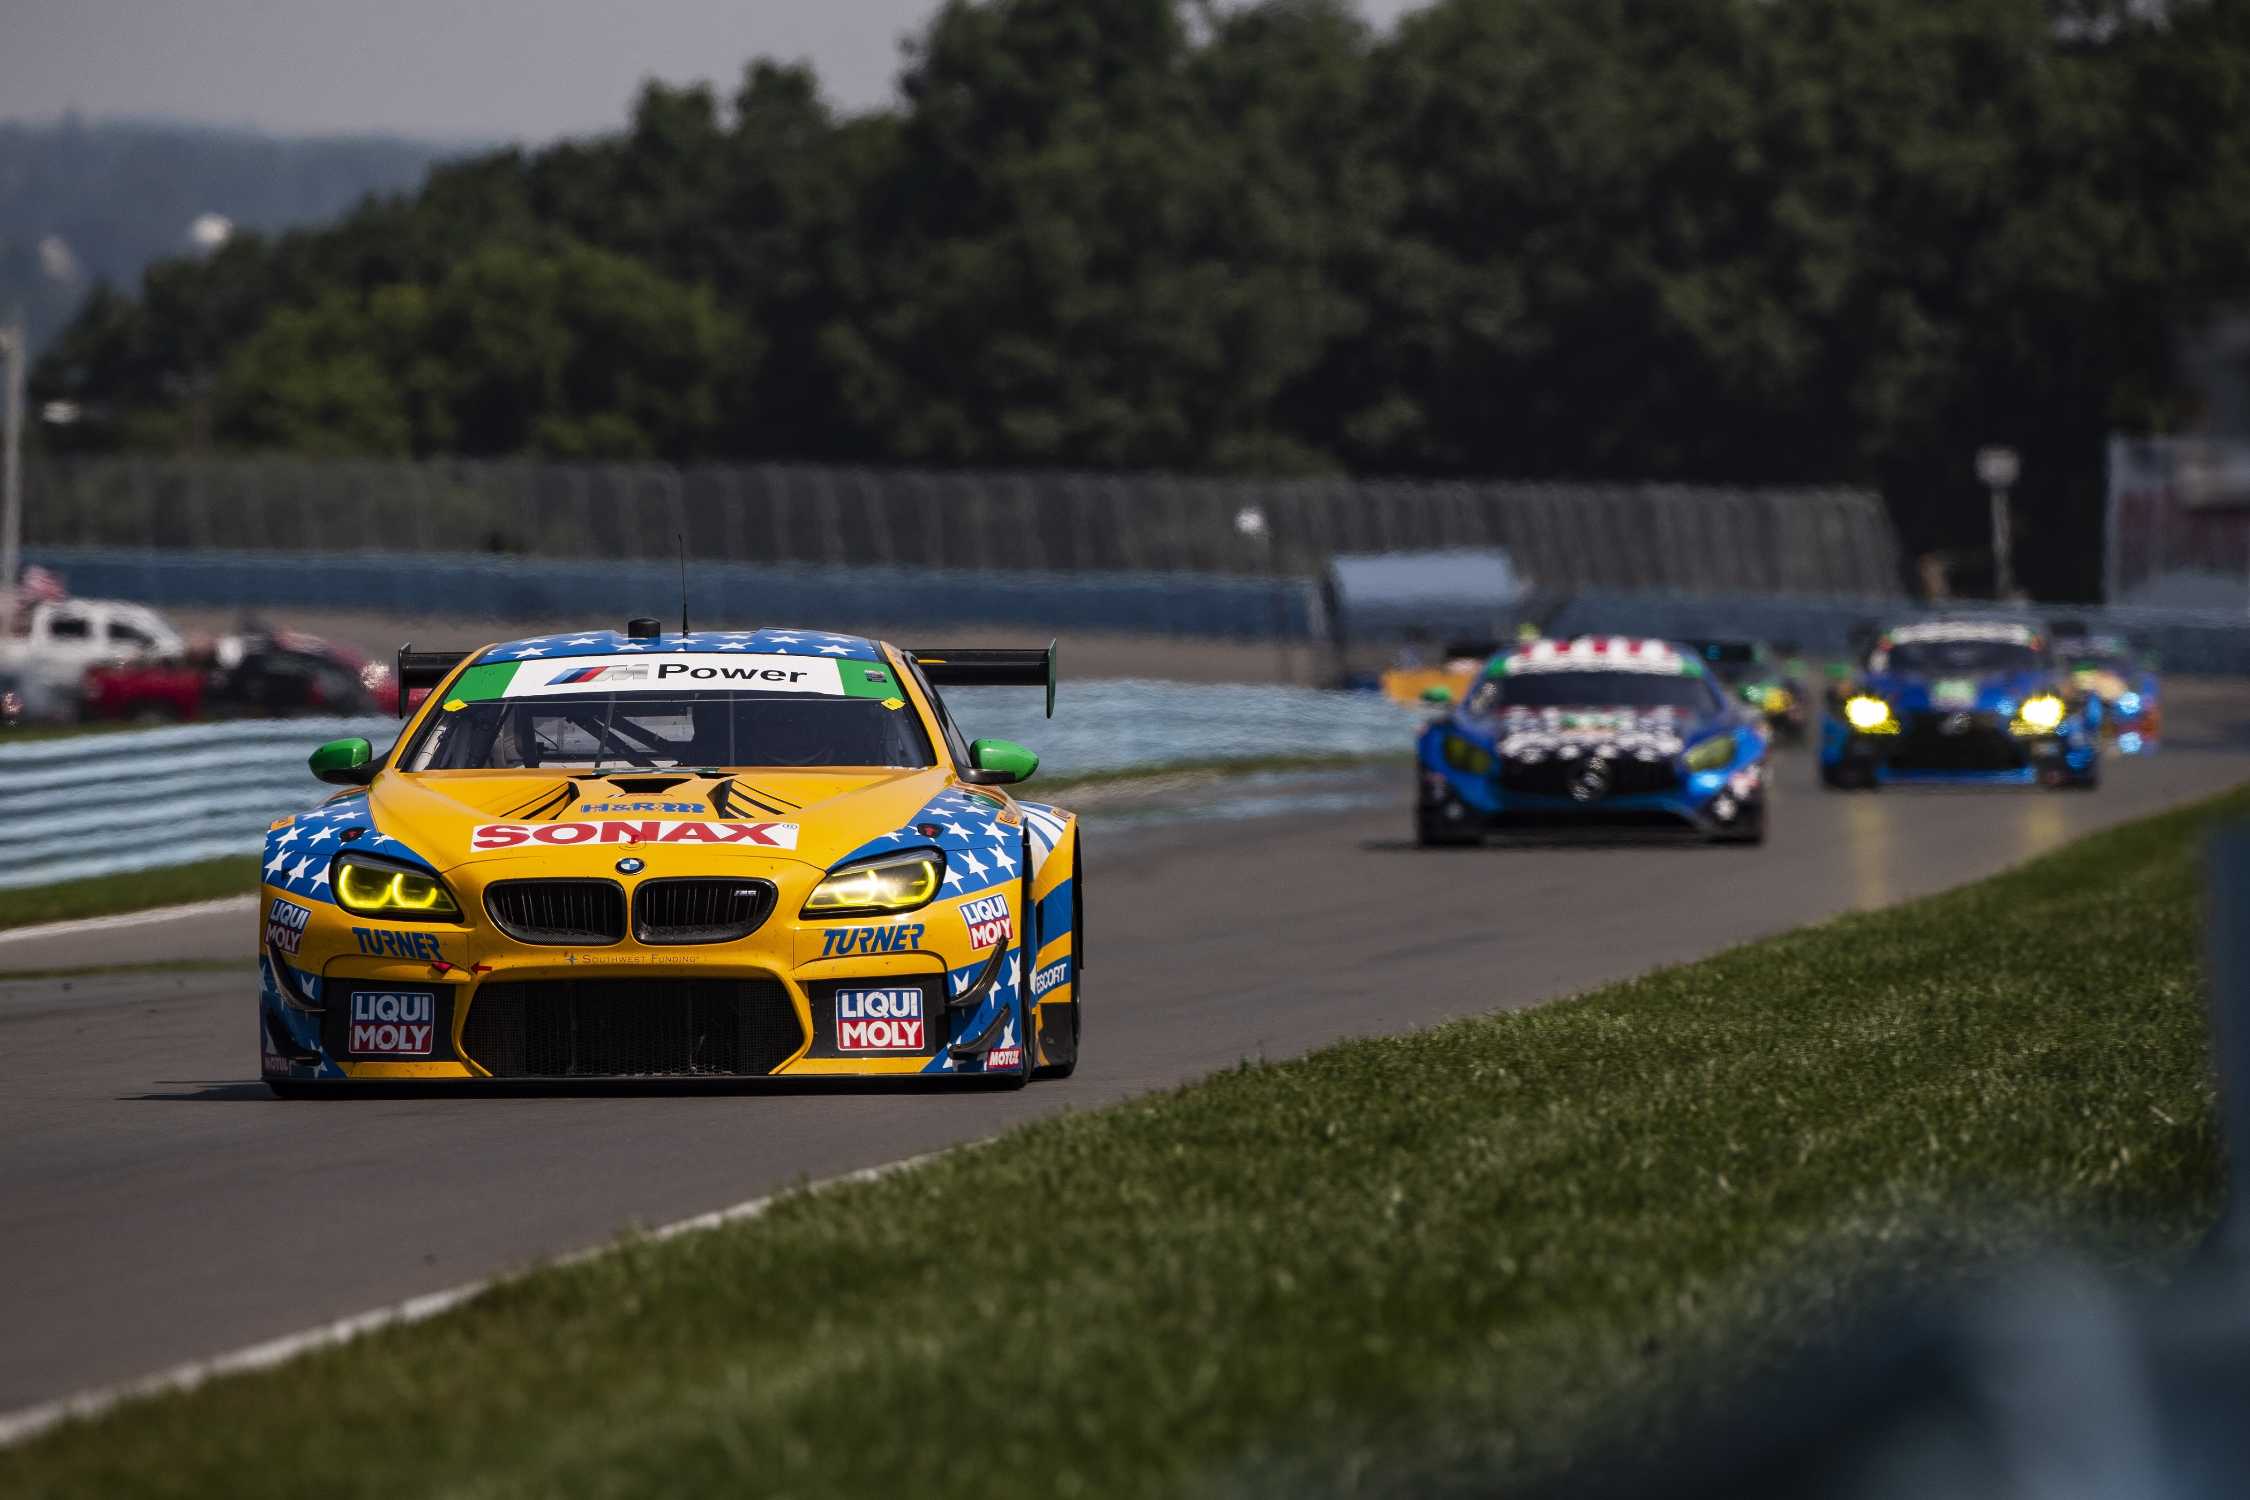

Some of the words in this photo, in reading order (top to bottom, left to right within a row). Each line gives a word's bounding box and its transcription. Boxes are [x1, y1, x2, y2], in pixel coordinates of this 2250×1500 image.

[657, 663, 808, 684] Power
[473, 821, 781, 849] SONAX
[271, 900, 310, 930] LIQUI
[961, 896, 1009, 924] LIQUI
[265, 922, 302, 952] MOLY
[352, 926, 445, 961] TURNER
[822, 923, 926, 956] TURNER
[971, 919, 1013, 949] MOLY
[1036, 963, 1067, 994] ESCORT
[355, 995, 430, 1022] LIQUI
[842, 991, 919, 1018] LIQUI
[354, 1025, 432, 1050] MOLY
[842, 1021, 921, 1047] MOLY
[989, 1050, 1020, 1065] MOTUL
